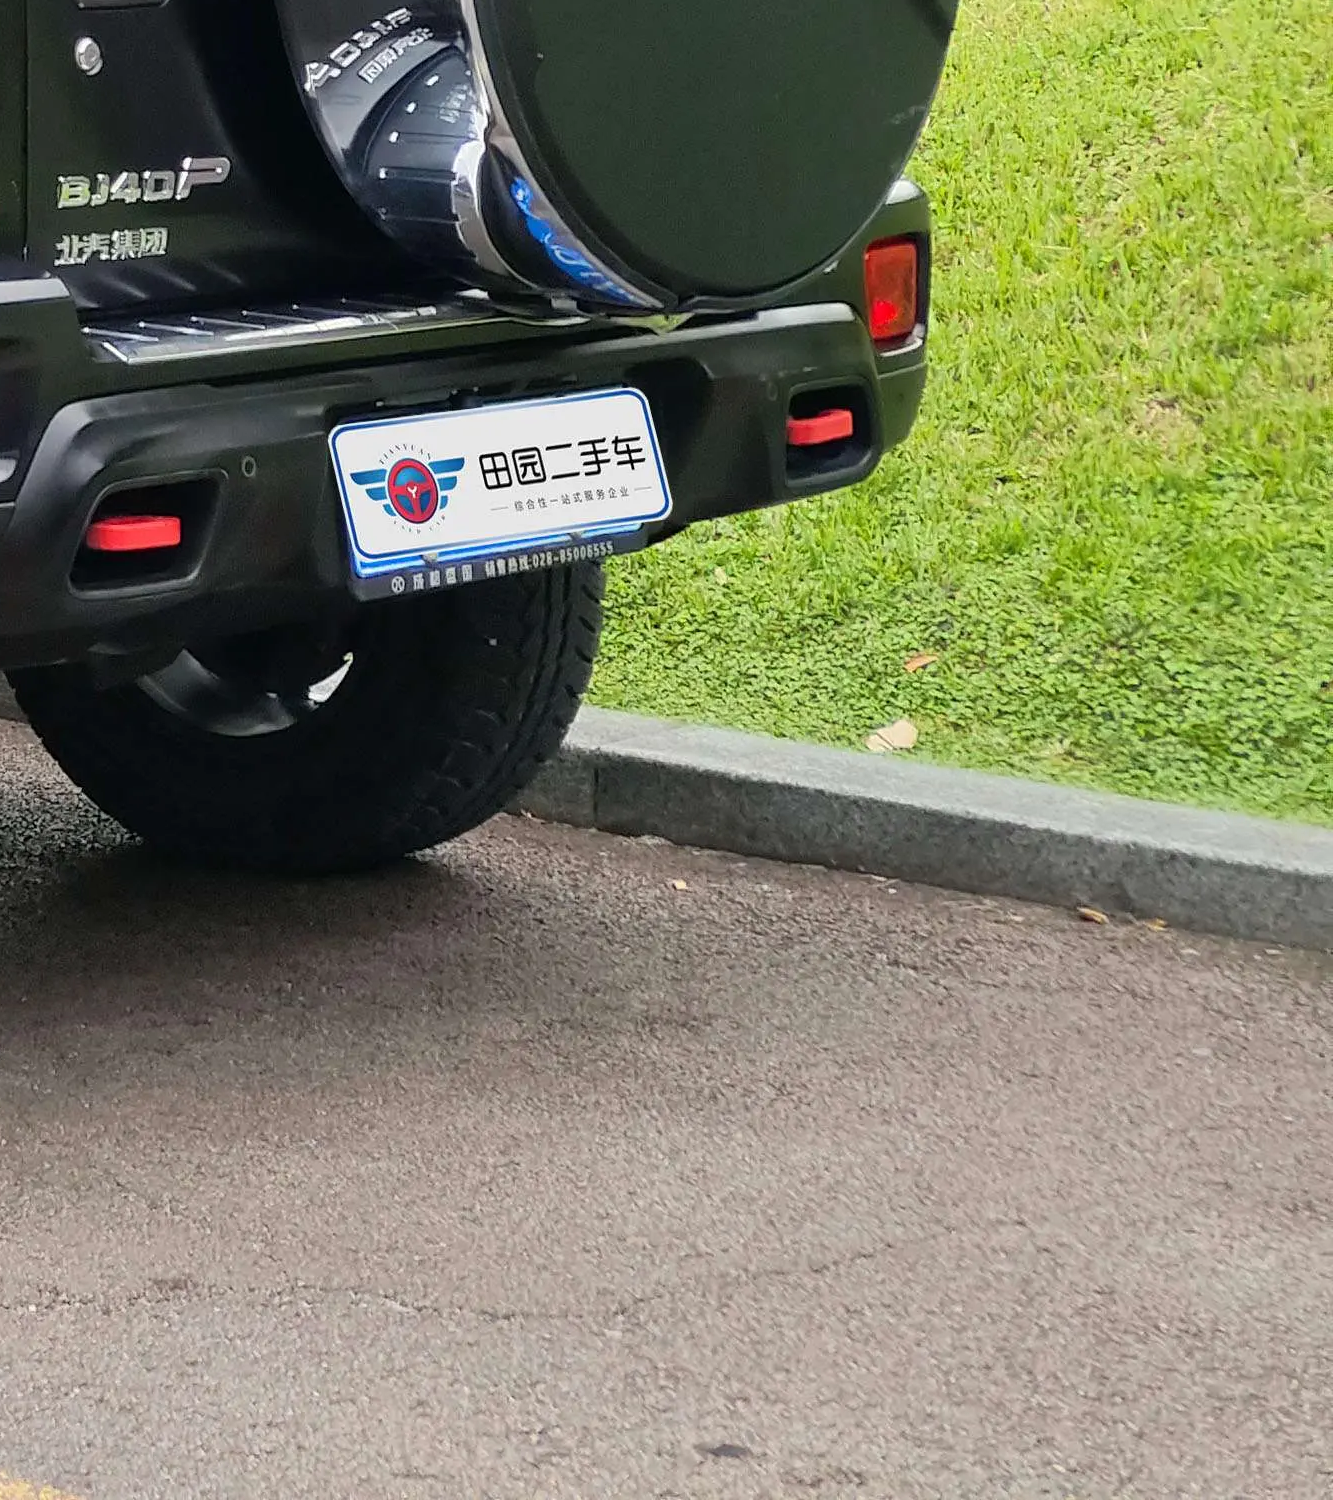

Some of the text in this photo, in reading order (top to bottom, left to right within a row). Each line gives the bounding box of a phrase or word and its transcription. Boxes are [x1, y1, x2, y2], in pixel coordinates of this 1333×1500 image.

[56, 156, 231, 209] BJ40P
[53, 227, 170, 267] 北汽集团
[478, 435, 647, 491] 田园二手车
